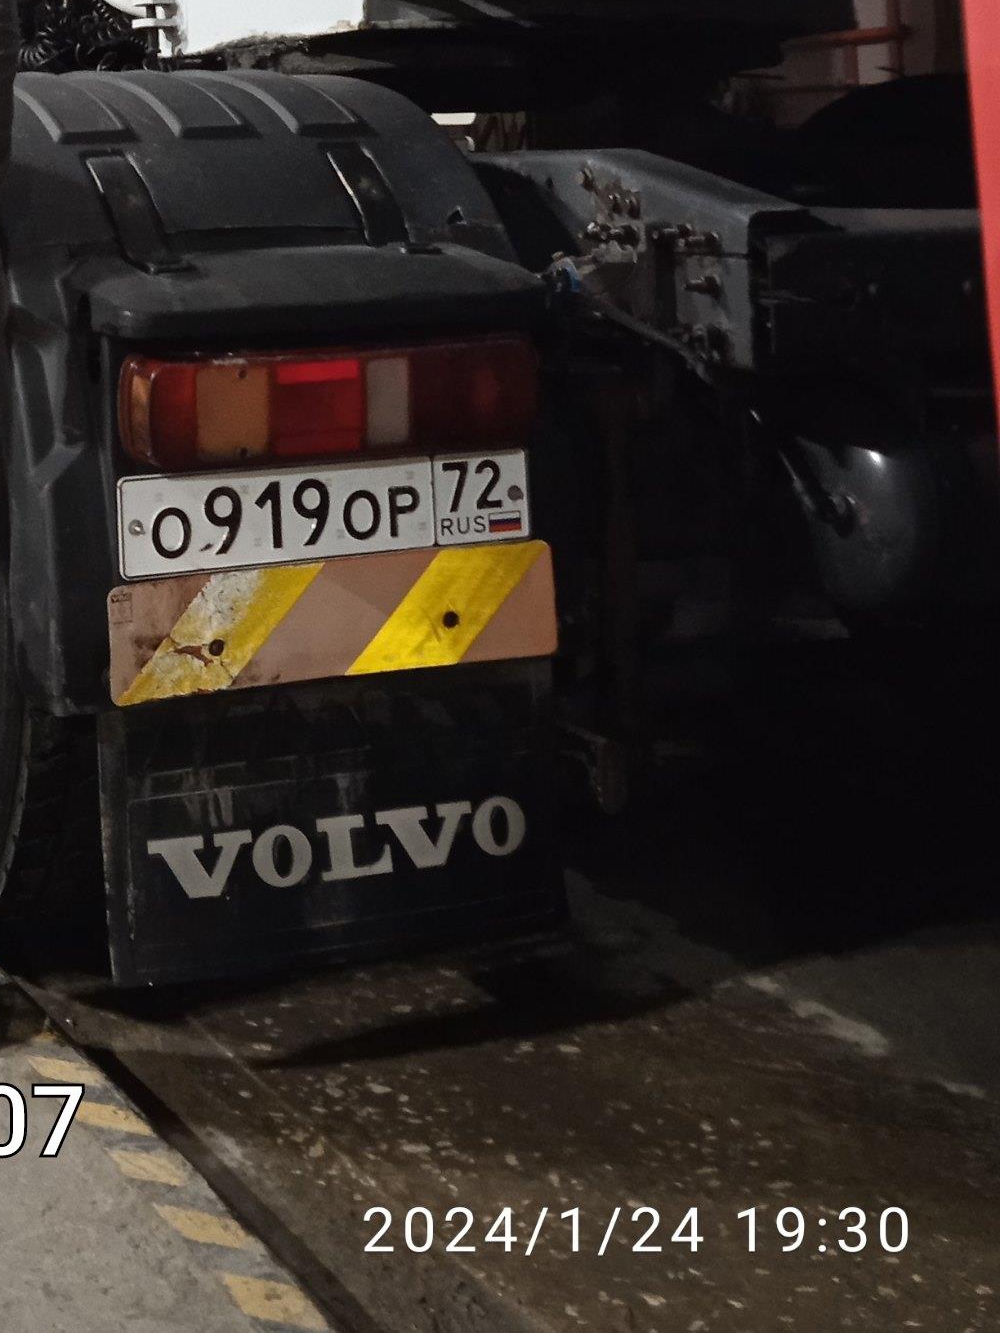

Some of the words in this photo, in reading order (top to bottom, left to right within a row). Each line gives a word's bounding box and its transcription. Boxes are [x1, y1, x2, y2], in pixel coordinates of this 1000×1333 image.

[442, 459, 503, 513] 72
[440, 515, 487, 536] RUS
[147, 796, 525, 899] VOLVO
